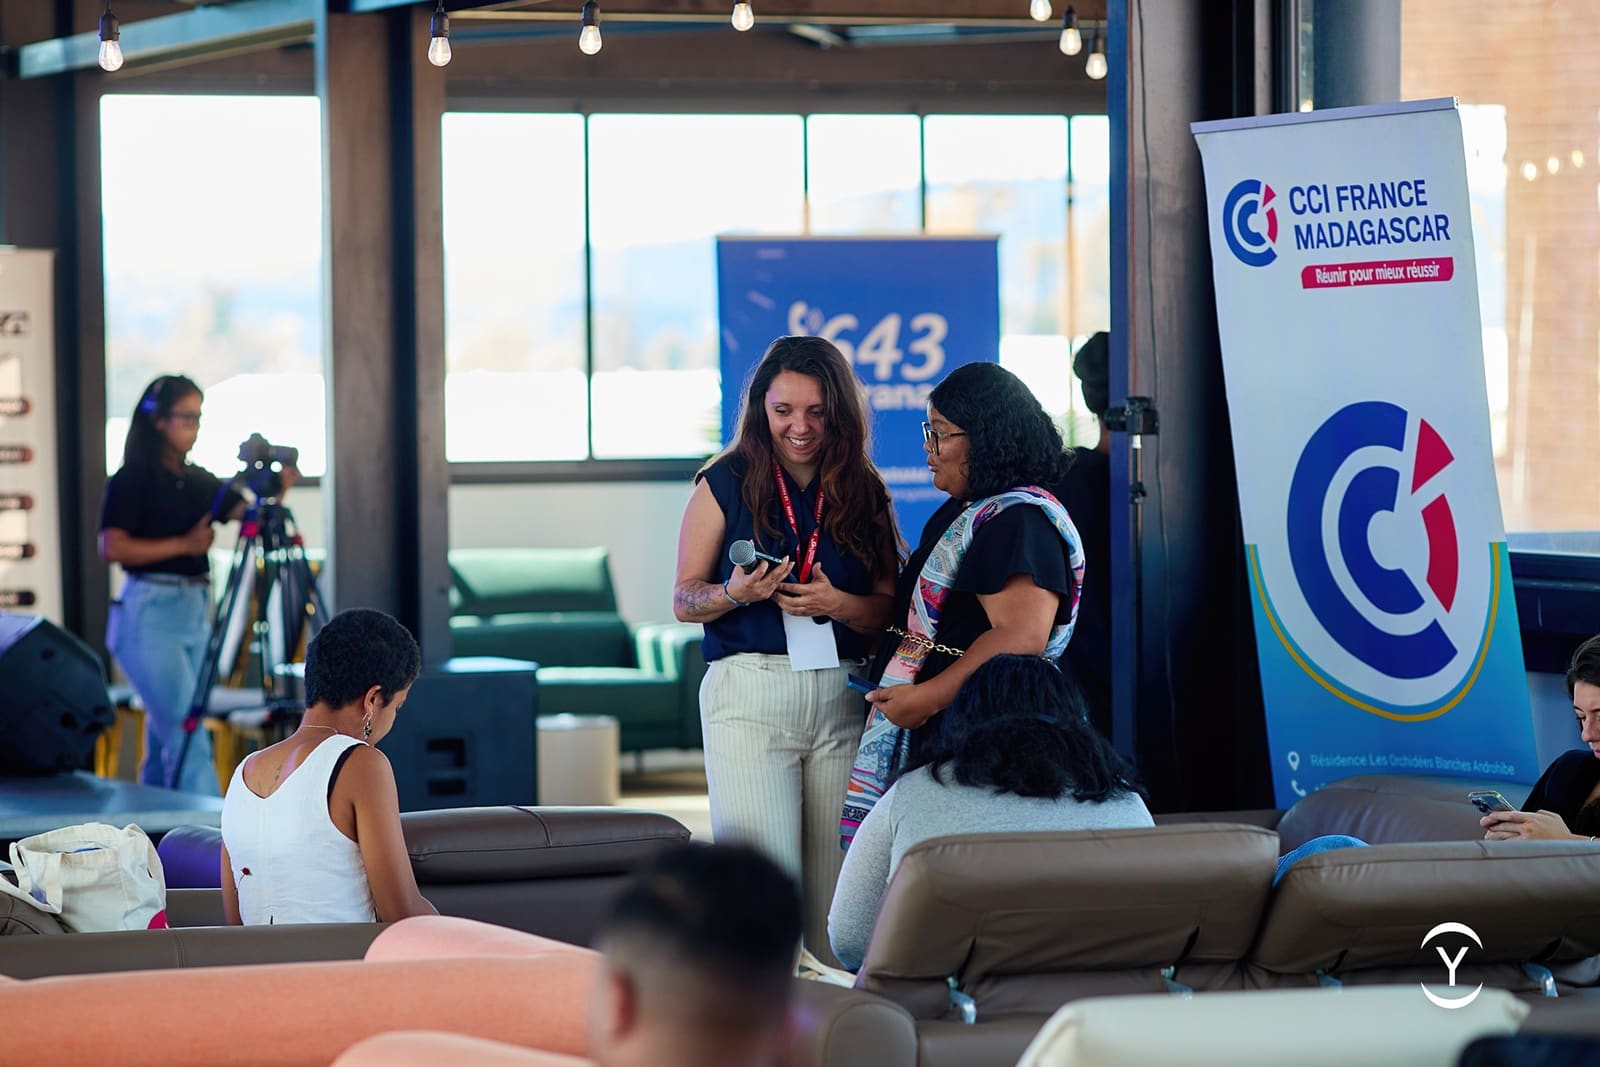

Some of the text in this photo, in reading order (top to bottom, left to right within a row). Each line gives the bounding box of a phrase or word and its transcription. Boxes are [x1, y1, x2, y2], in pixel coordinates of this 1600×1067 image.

[1289, 179, 1428, 215] CCI FRANCE
[1294, 214, 1451, 250] MADAGASCAR
[1315, 261, 1440, 286] Réunir pour mieux réussir
[1310, 753, 1367, 768] Résidence
[1368, 752, 1388, 767] Les
